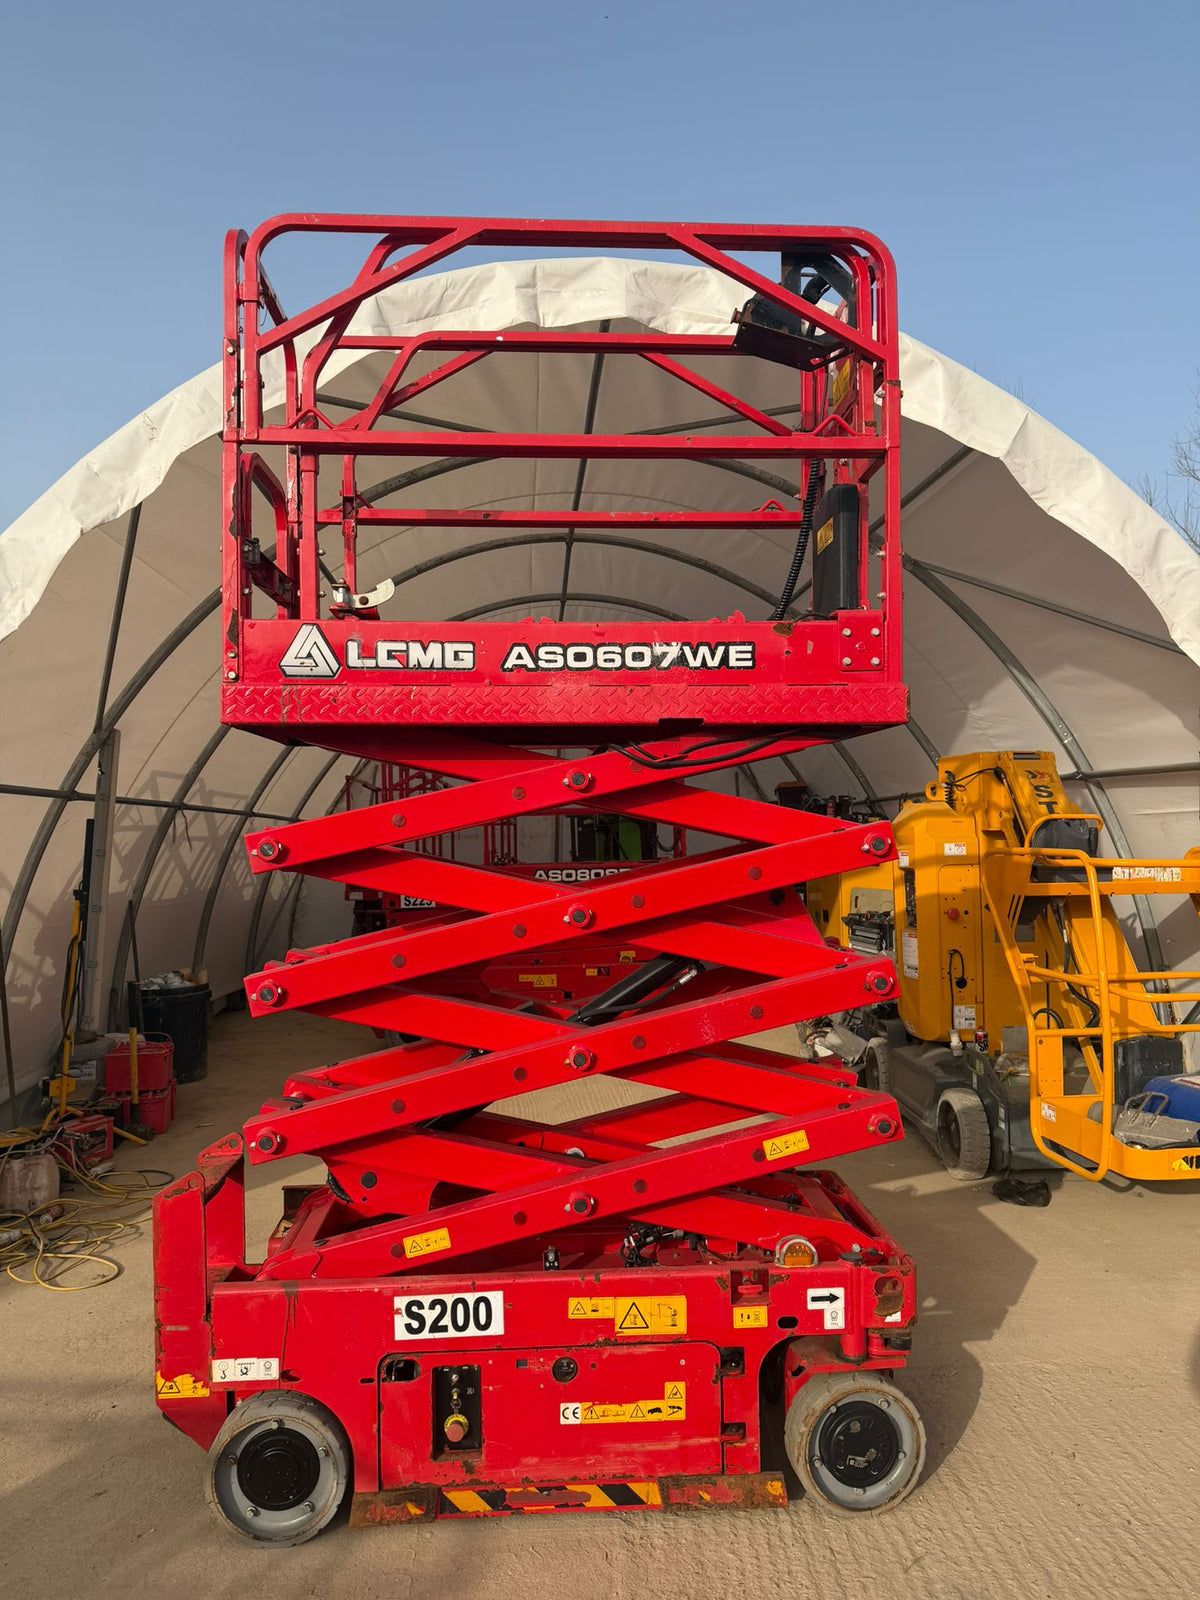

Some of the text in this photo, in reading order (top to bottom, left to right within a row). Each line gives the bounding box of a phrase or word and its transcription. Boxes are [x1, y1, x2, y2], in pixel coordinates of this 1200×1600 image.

[346, 640, 475, 670] LGMG
[534, 868, 632, 882] AS080
[404, 1295, 493, 1335] S200
